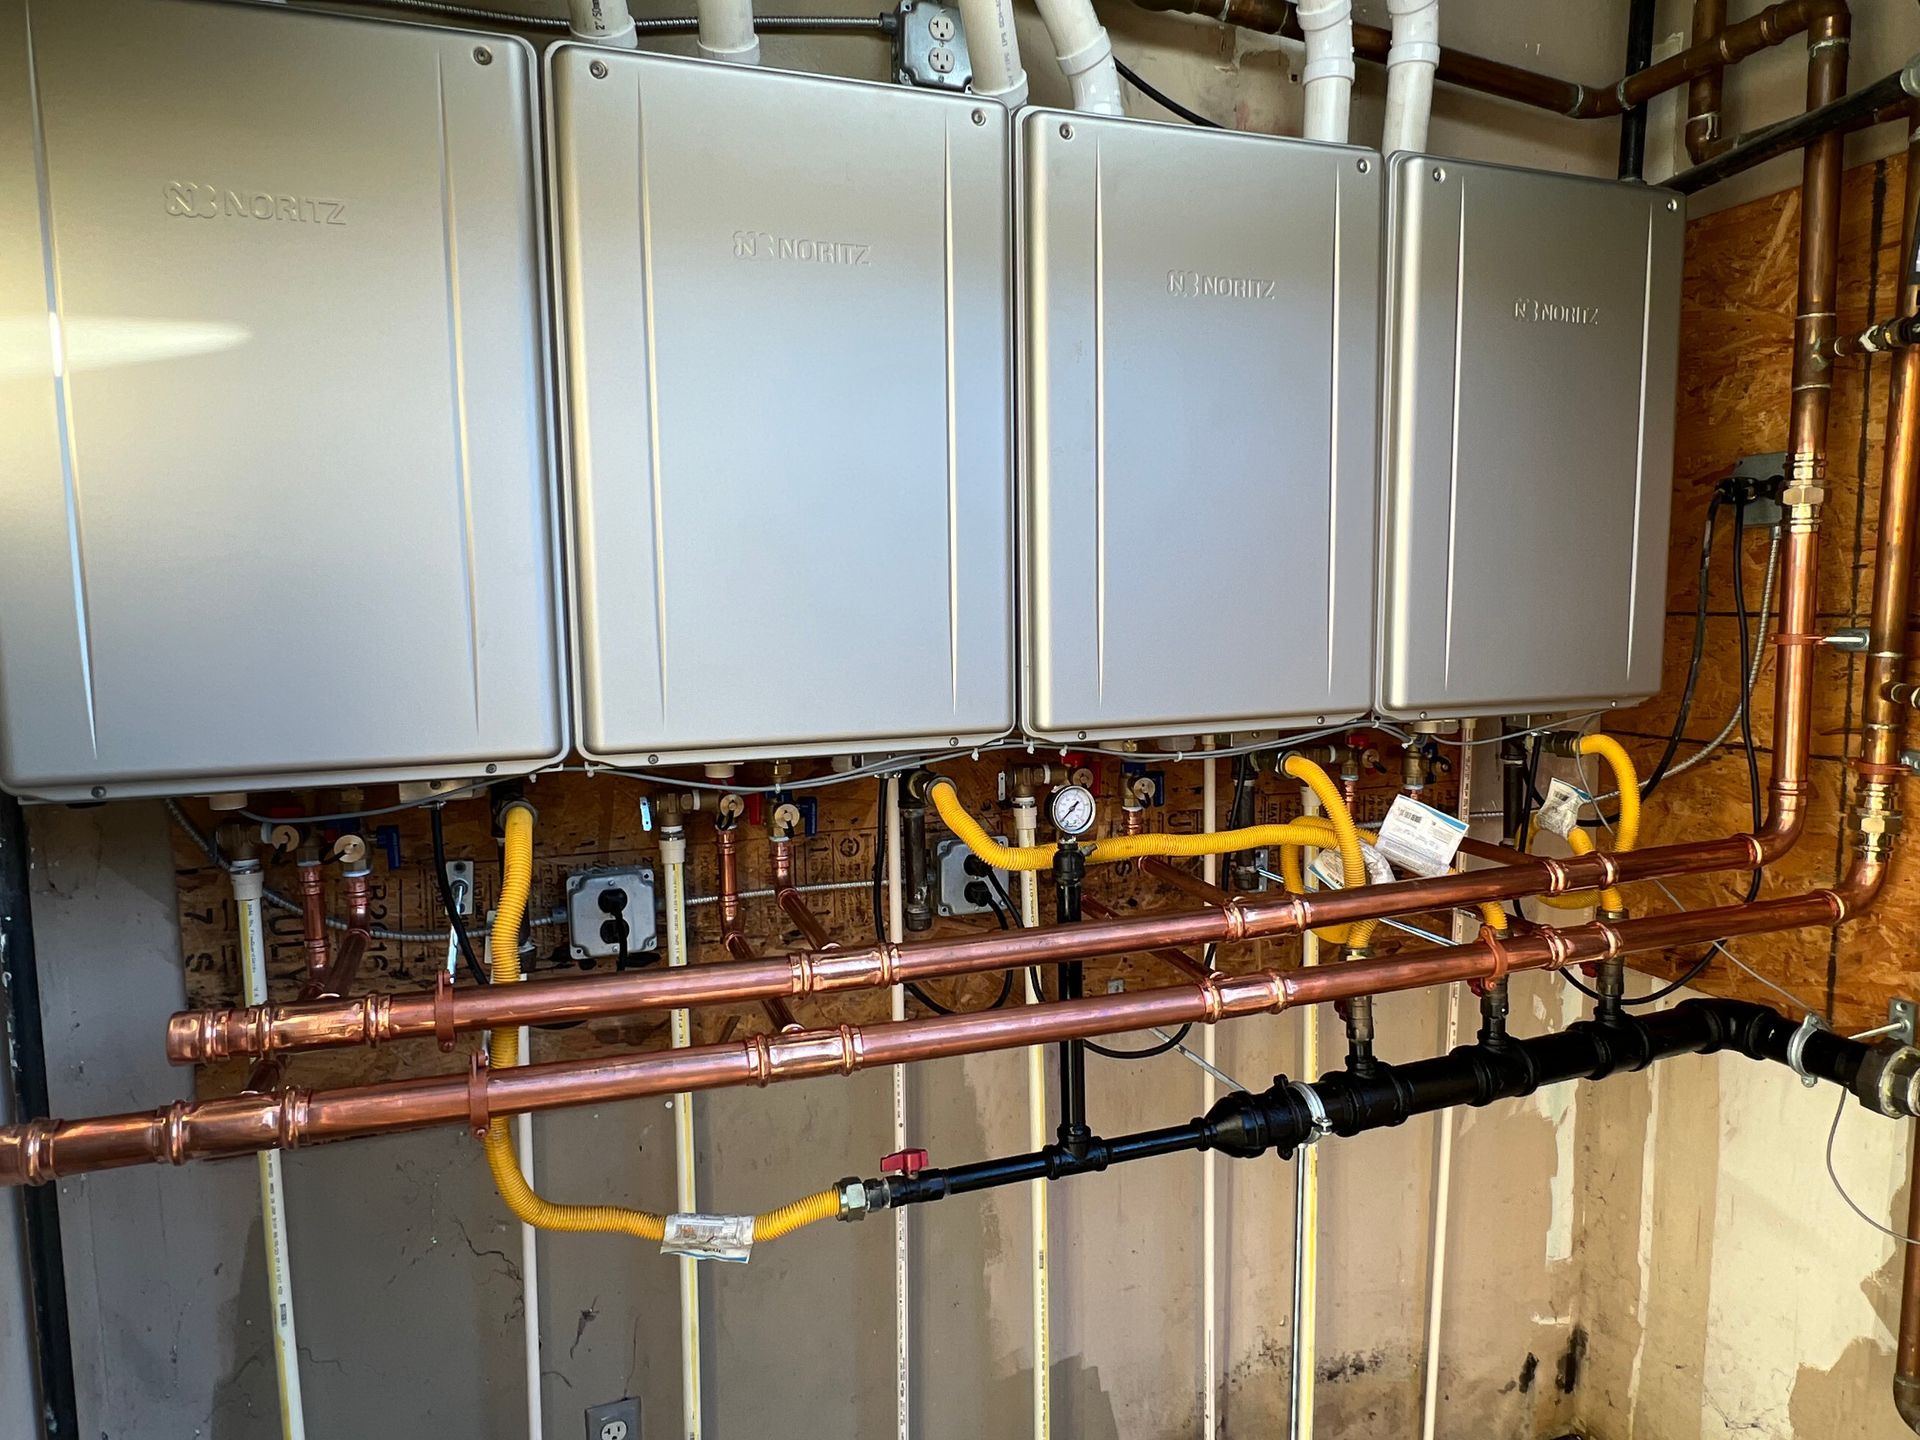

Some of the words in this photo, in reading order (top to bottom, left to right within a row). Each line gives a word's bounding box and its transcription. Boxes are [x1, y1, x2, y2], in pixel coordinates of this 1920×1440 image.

[224, 188, 346, 226] NORITZ
[778, 237, 872, 266] NORITZ
[1201, 275, 1276, 300] NORITZ
[1540, 303, 1599, 325] NORITZ
